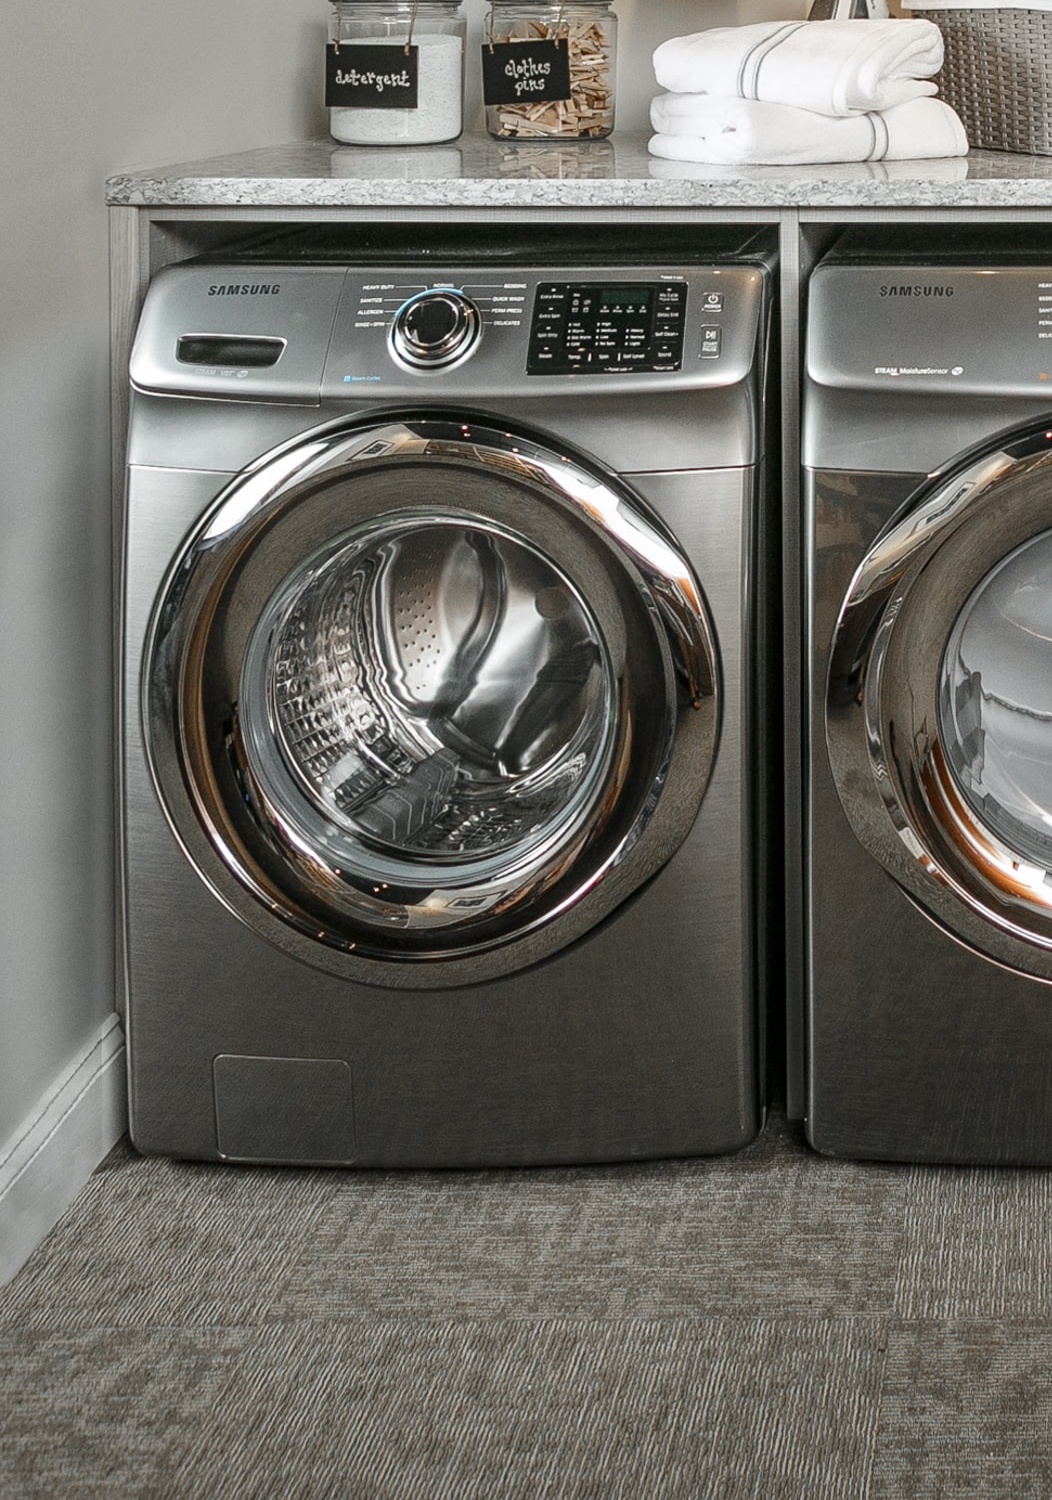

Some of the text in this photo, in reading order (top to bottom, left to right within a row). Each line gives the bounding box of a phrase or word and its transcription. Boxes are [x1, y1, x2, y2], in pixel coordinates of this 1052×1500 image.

[504, 57, 551, 78] clothes
[335, 69, 411, 92] detergent
[514, 77, 545, 96] pins
[208, 284, 281, 296] SAMSUNG
[880, 286, 954, 297] SAMSUNG
